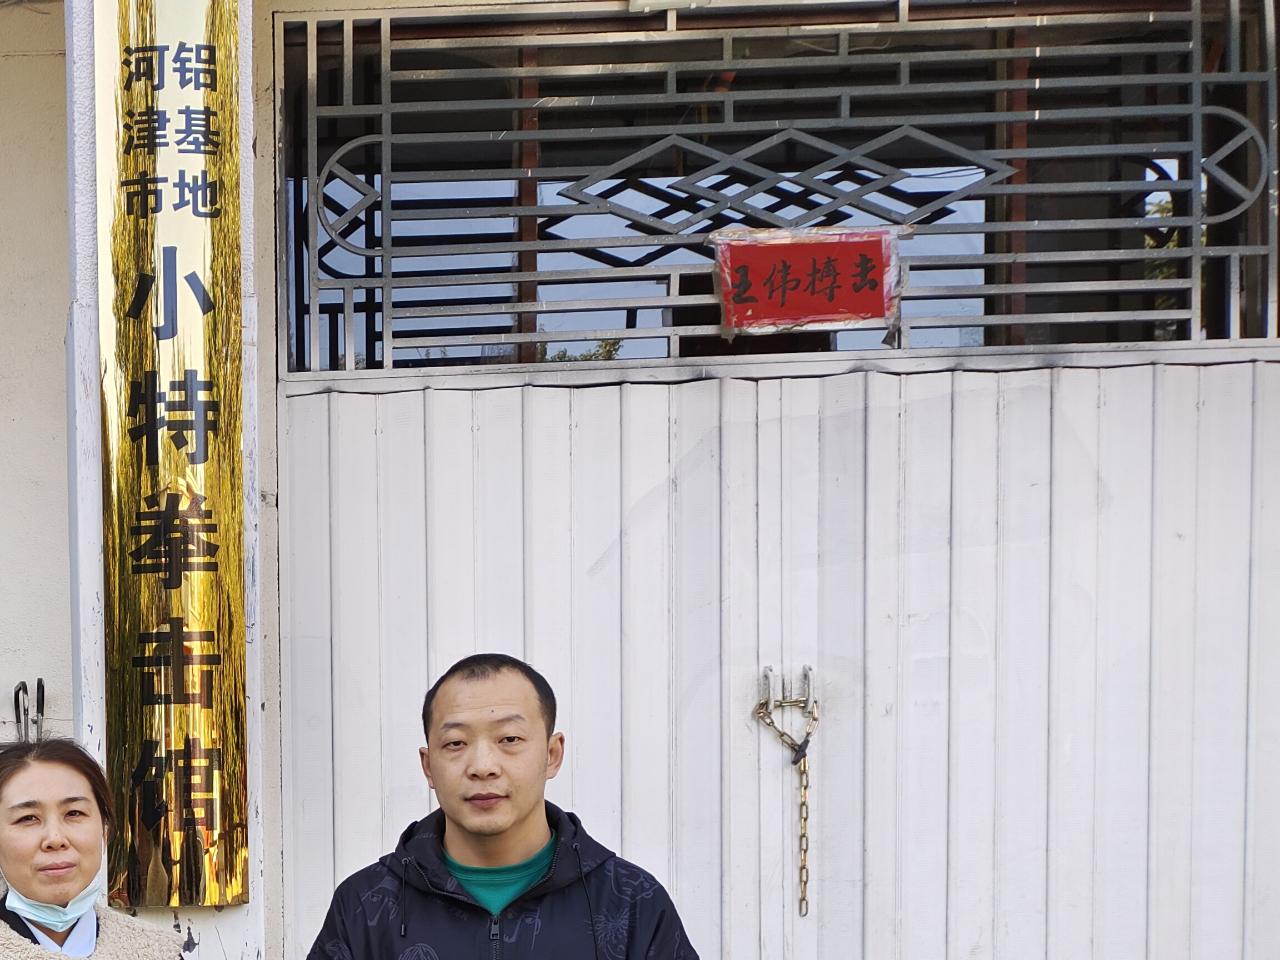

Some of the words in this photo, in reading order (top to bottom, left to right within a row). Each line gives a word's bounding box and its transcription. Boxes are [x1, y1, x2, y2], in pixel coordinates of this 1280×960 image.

[121, 44, 170, 219] 河津市
[172, 41, 221, 219] 铝基地
[125, 246, 223, 832] 小特拳击馆
